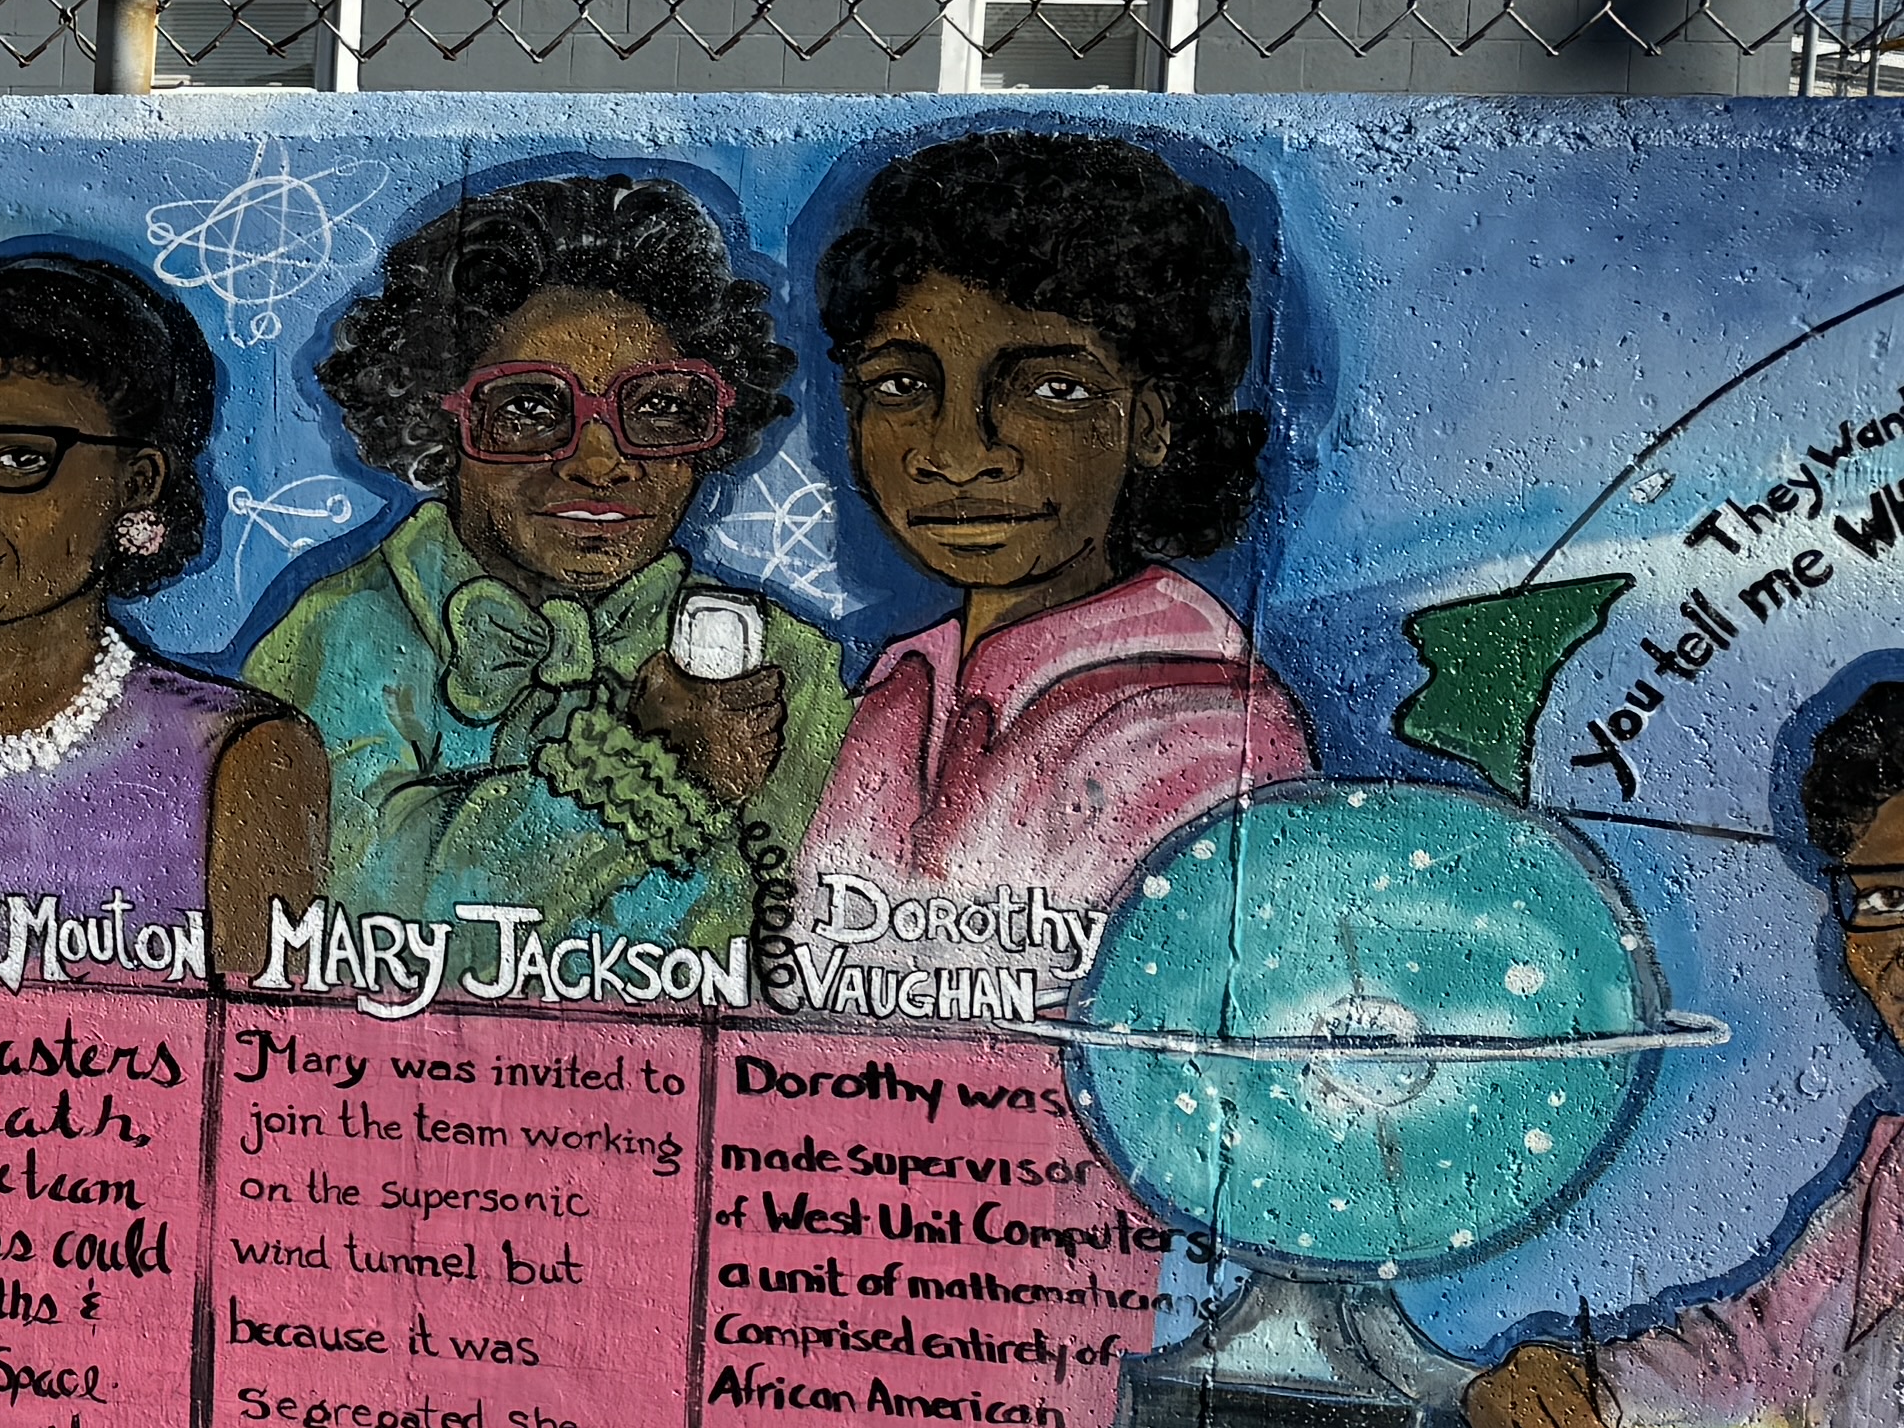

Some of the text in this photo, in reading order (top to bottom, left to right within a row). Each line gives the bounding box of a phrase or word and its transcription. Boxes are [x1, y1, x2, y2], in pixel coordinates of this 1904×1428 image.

[1683, 386, 1904, 554] They Wan
[1640, 588, 1739, 683] tell
[1738, 548, 1834, 625] me
[249, 895, 751, 1021] MARY JACKSON
[794, 943, 1036, 1023] VAUGHAN
[234, 1030, 685, 1096] Mary was invited to
[736, 1055, 1069, 1122] Dorothy was
